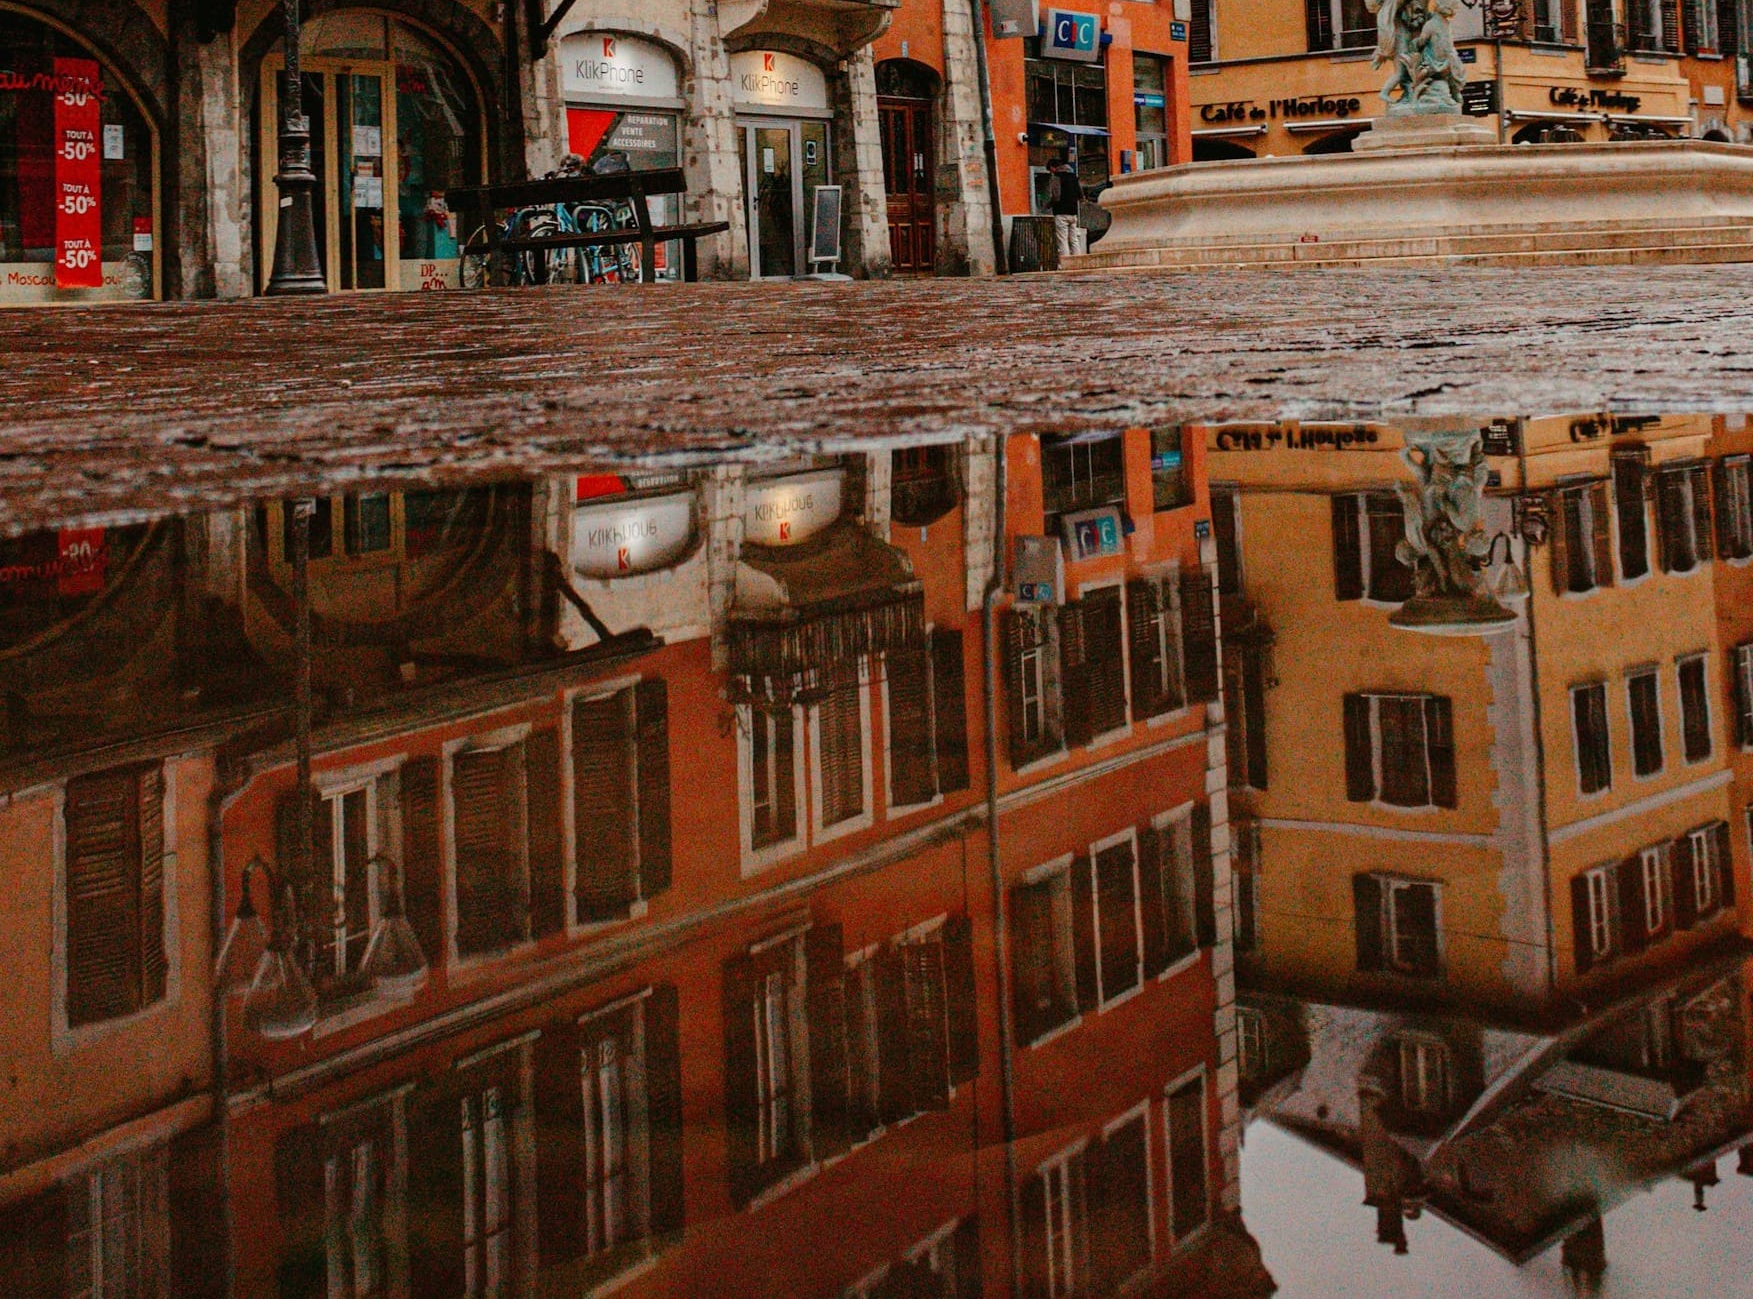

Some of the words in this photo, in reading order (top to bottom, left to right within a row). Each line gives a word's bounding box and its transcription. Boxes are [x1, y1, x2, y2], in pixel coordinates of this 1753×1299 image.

[1058, 20, 1090, 44] CIC
[576, 60, 643, 83] KlikPhone
[741, 73, 798, 95] KlikPhone
[1201, 103, 1245, 122] Café
[1249, 107, 1266, 119] de
[66, 130, 87, 140] TOUT
[621, 127, 643, 136] VENTE
[58, 142, 96, 160] -50%
[613, 138, 656, 148] ACCESSOIRES
[63, 183, 83, 193] TOUT
[58, 195, 97, 214] -50%
[64, 240, 84, 249] TOUT
[58, 250, 97, 268] -50%
